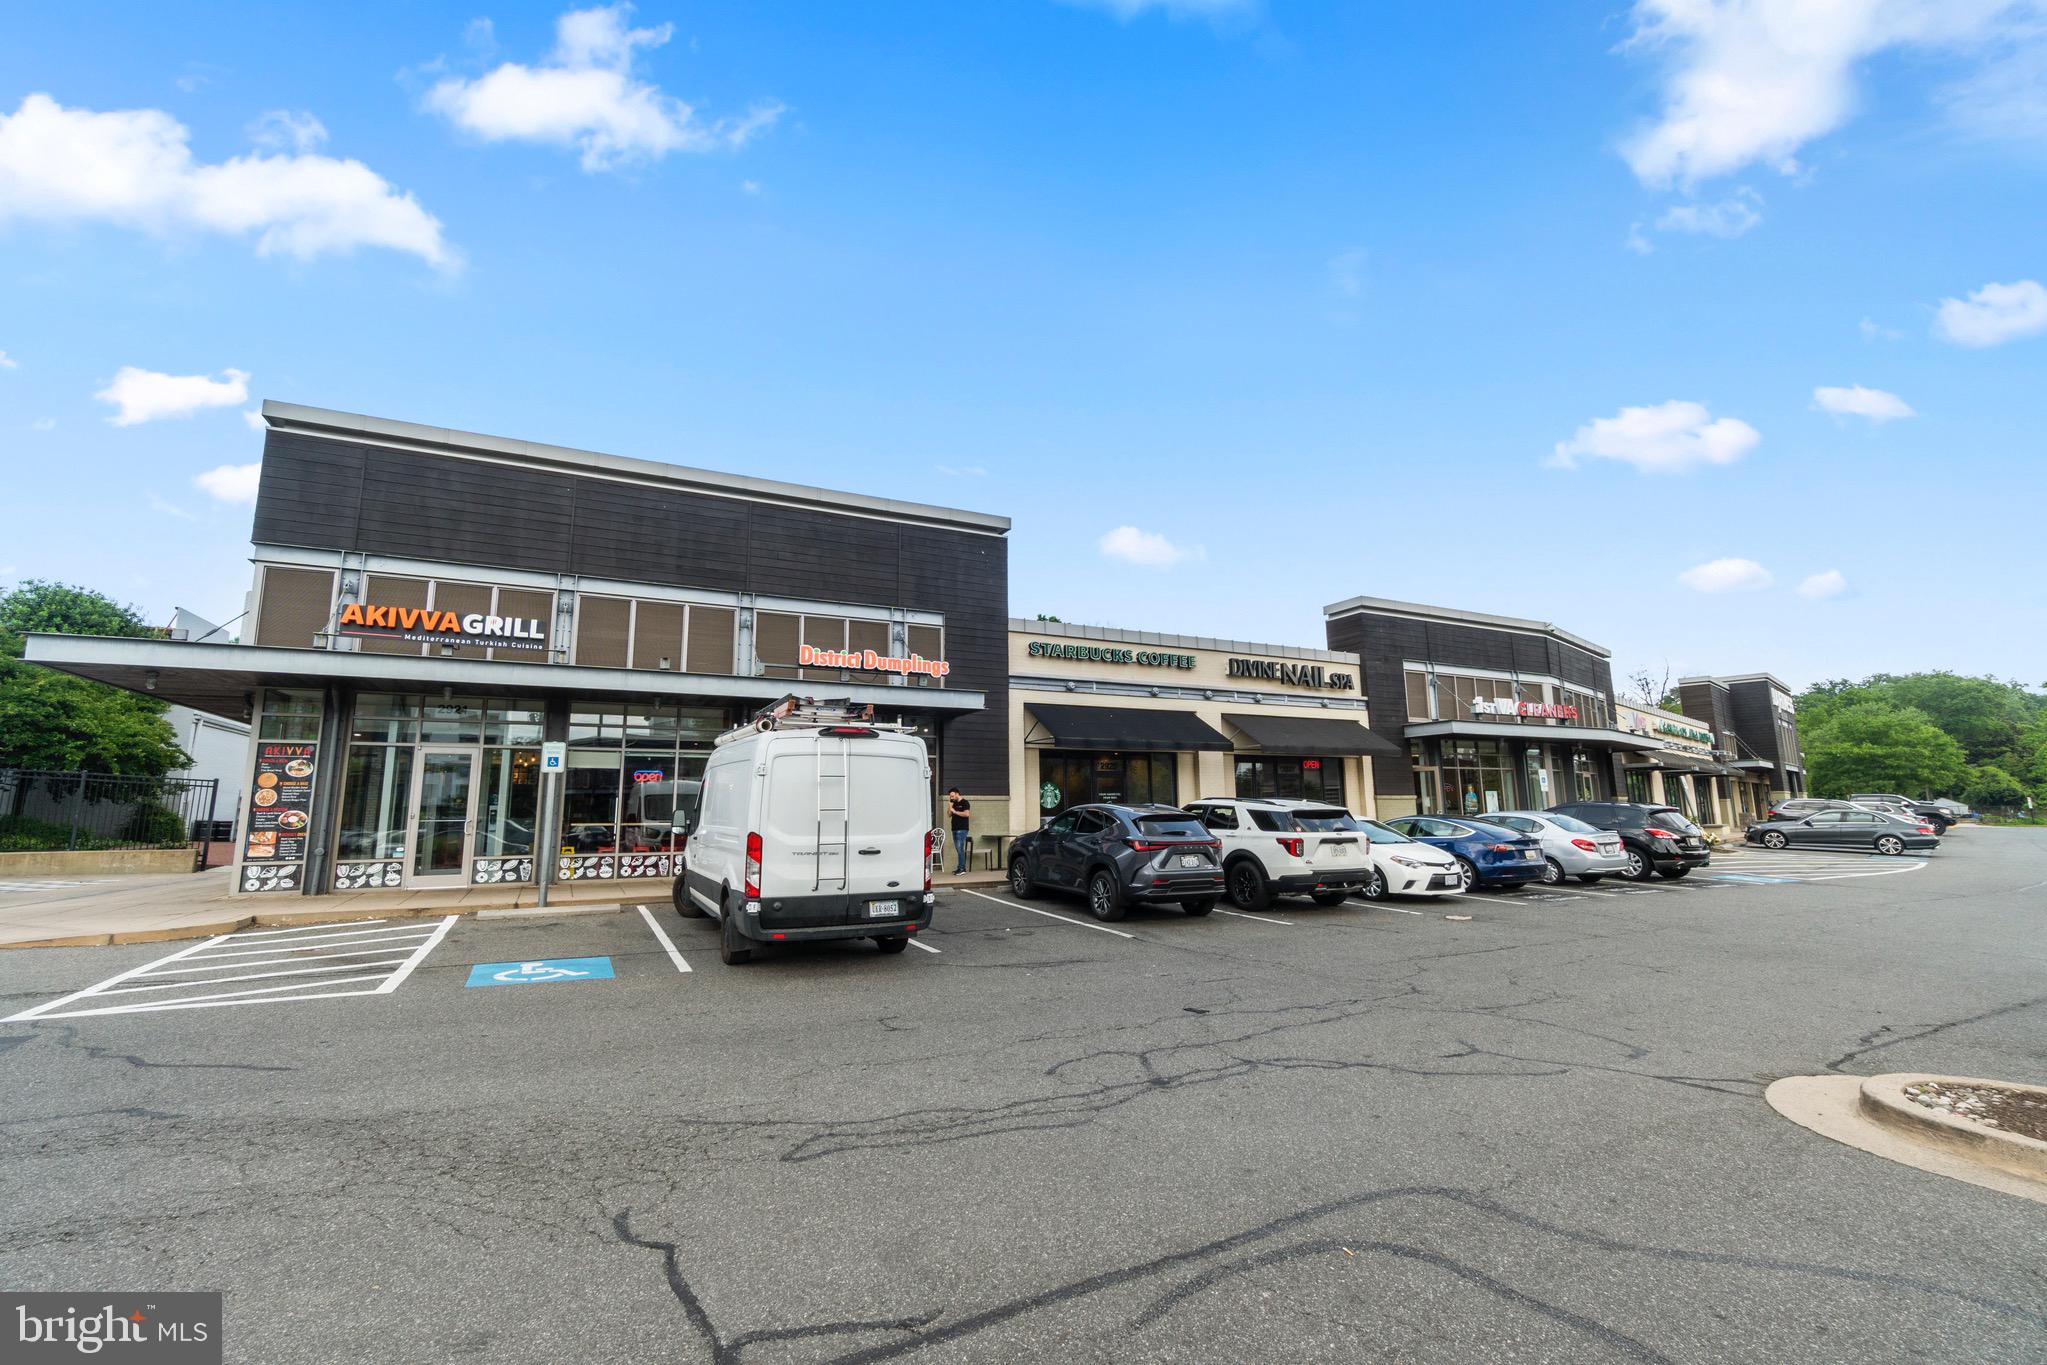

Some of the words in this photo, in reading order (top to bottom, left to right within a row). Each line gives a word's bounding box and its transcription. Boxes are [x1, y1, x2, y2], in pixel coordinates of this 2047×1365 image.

[340, 603, 461, 633] AKIVVA
[462, 613, 545, 640] GRILL
[404, 634, 471, 645] Mediterranean
[475, 639, 508, 648] Turkish
[511, 642, 543, 650] Cuisine
[1028, 641, 1134, 663] STARBUCKS
[1136, 651, 1197, 669] COFFEE
[799, 644, 862, 669] District
[863, 649, 950, 678] Dumplings
[1228, 657, 1281, 680] DIVINE
[1280, 662, 1329, 689] NAIL
[1329, 672, 1355, 690] SPA
[1517, 700, 1579, 719] CLEANERS
[1303, 760, 1321, 769] OPEN
